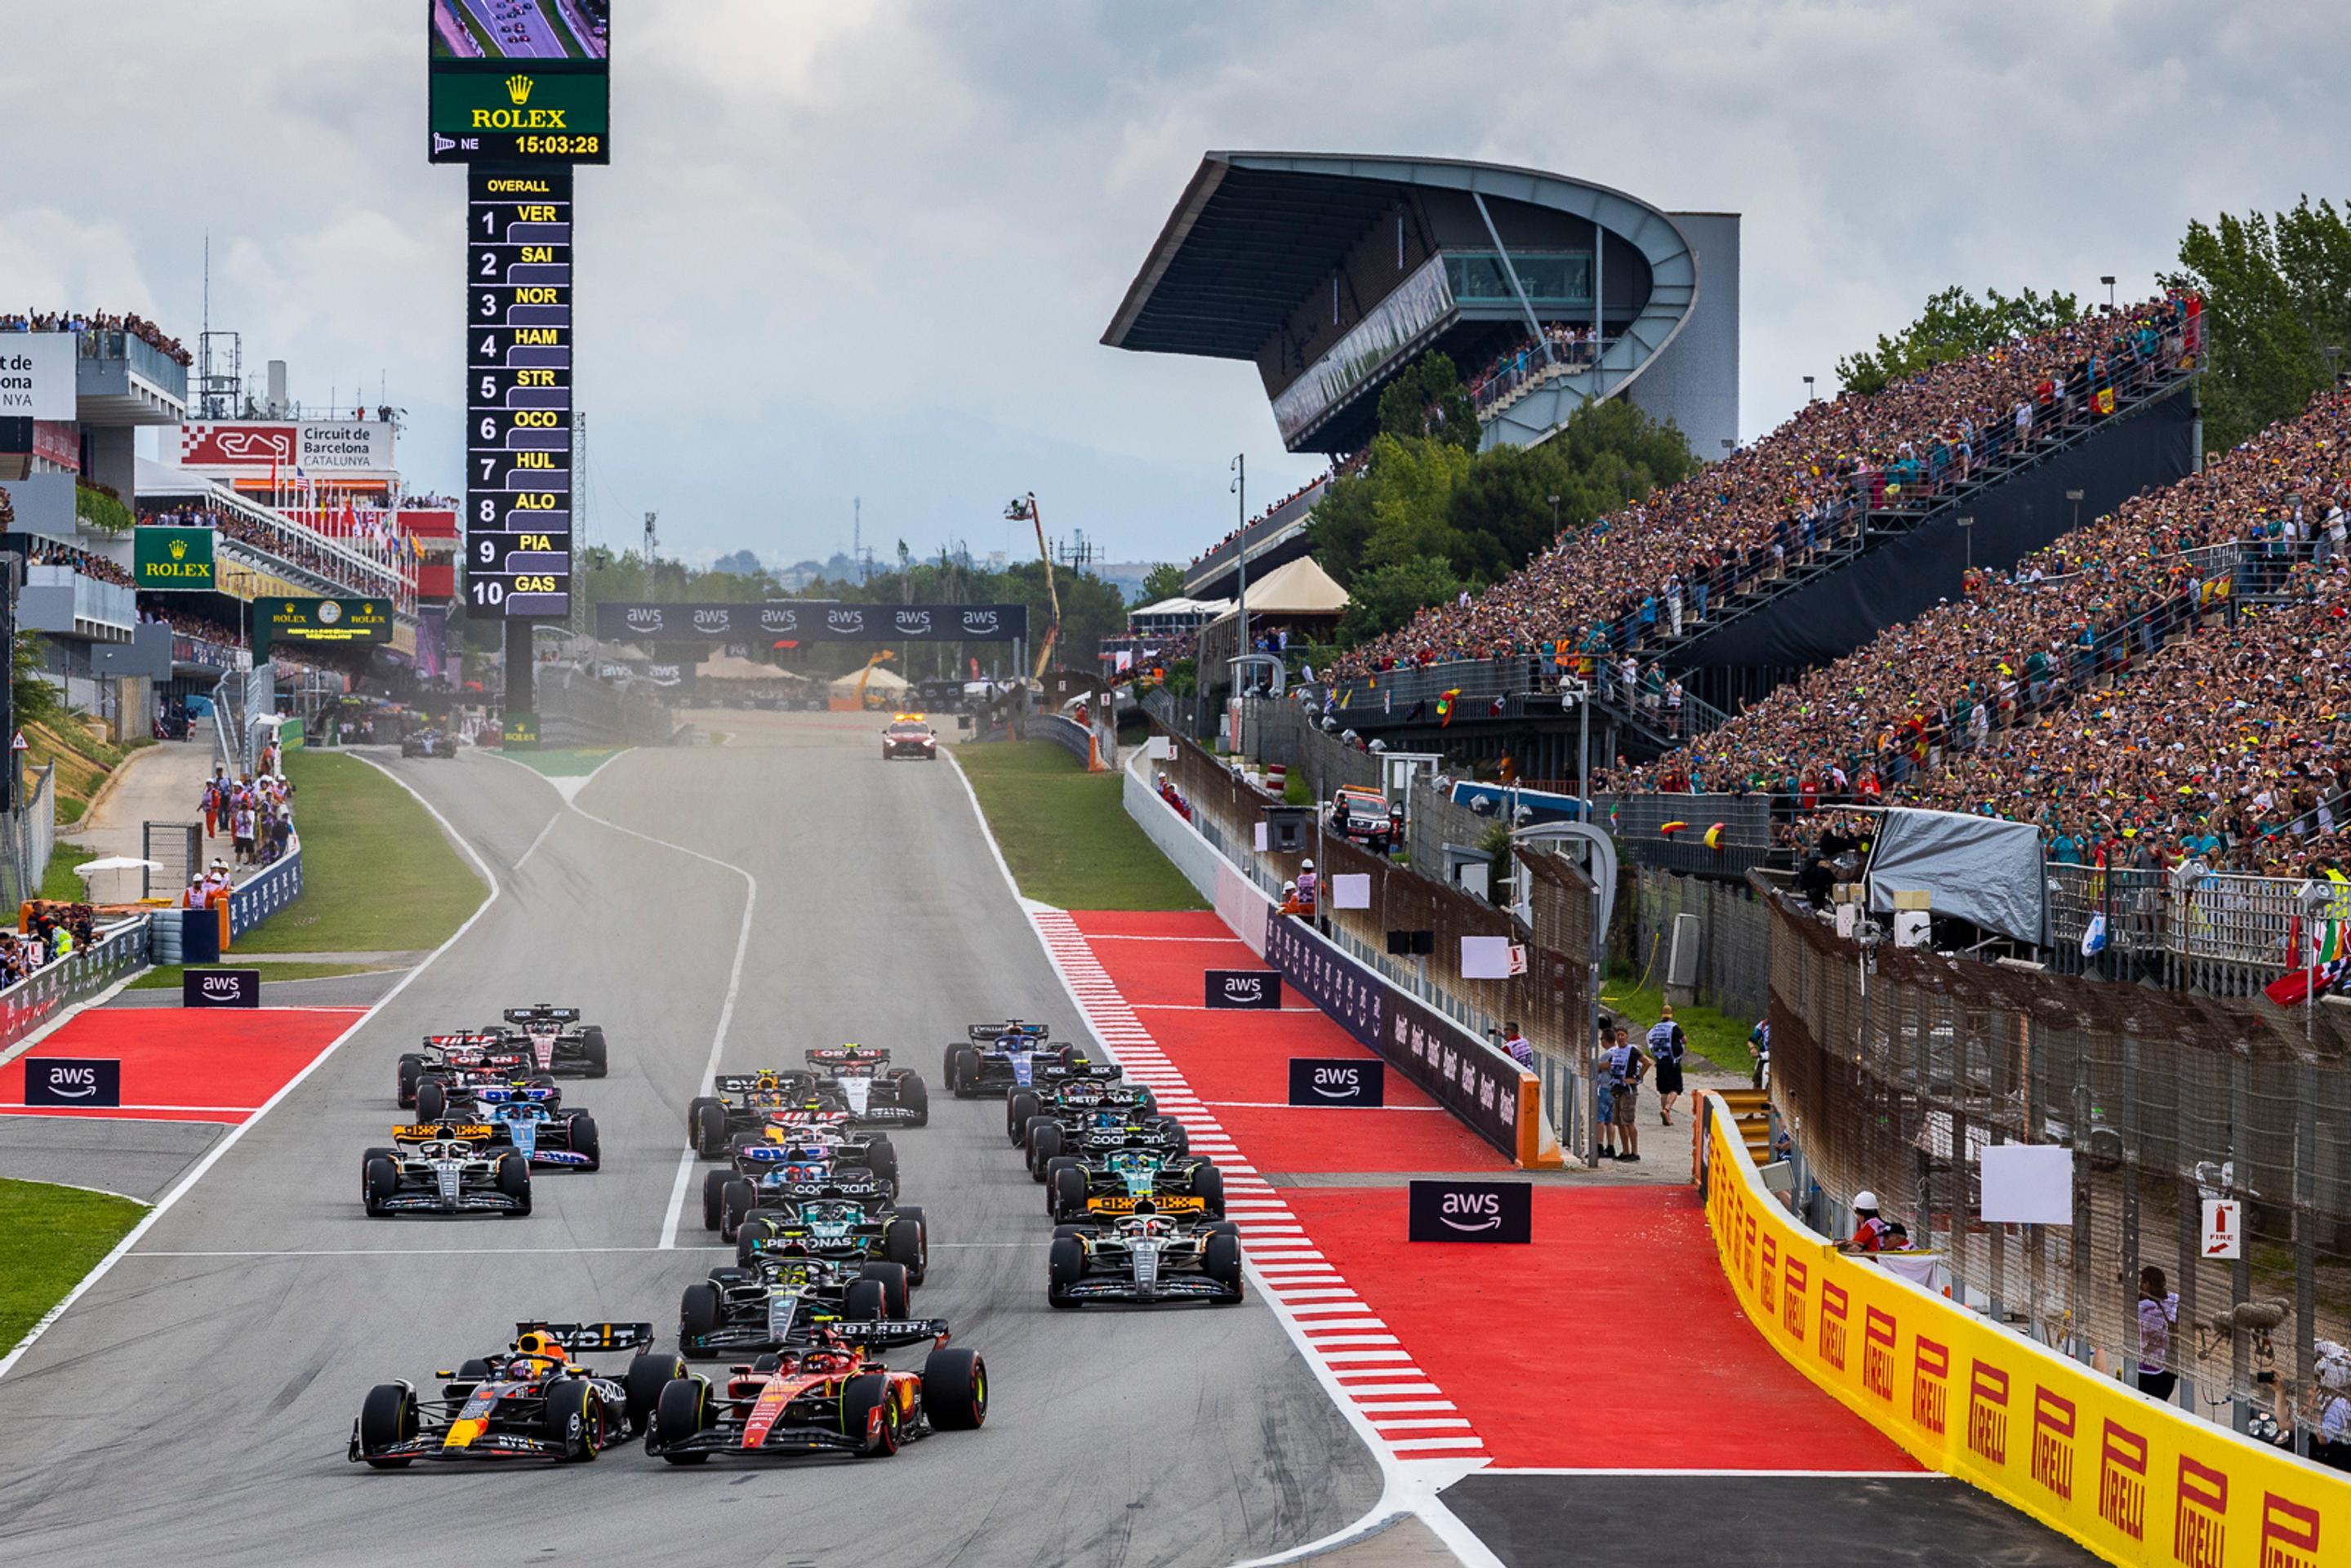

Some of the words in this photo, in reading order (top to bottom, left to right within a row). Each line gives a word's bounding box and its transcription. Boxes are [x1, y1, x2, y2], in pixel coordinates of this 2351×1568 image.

[472, 109, 566, 127] ROLEX
[461, 138, 479, 149] NE
[516, 136, 599, 154] 15:03:28
[488, 180, 550, 192] OVERALL
[482, 212, 493, 234] 1
[518, 206, 556, 221] VER
[481, 253, 496, 275] 2
[521, 247, 552, 262] SAI
[481, 294, 496, 316] 3
[515, 288, 557, 303] NOR
[480, 335, 496, 357] 4
[515, 330, 557, 345] HAM
[11, 354, 32, 370] de
[481, 376, 496, 399] 5
[517, 371, 555, 385] STR
[3, 394, 32, 406] NYA
[304, 428, 351, 439] Circuit
[354, 428, 370, 440] de
[480, 417, 496, 439] 6
[514, 412, 557, 426] OCO
[304, 443, 369, 453] Barcelona
[304, 456, 370, 466] CATALUNYA
[480, 459, 496, 480] 7
[517, 453, 554, 468] HUL
[480, 500, 496, 522] 8
[515, 494, 555, 509] ALO
[480, 541, 495, 563] 9
[520, 536, 551, 550] PIA
[146, 564, 210, 577] ROLEX
[473, 581, 503, 605] 10
[514, 577, 555, 591] GAS
[627, 608, 661, 622] aws
[693, 610, 728, 624] aws
[761, 610, 796, 623] aws
[827, 610, 862, 624] aws
[896, 611, 930, 625] aws
[963, 611, 997, 625] aws
[203, 977, 239, 991] aws
[1225, 978, 1261, 992] aws
[50, 1067, 95, 1084] aws
[1315, 1068, 1358, 1085] aws
[1442, 1193, 1499, 1214] aws
[1819, 1278, 1848, 1372] PIRELLI
[1863, 1303, 1896, 1401] PIRELLI
[1912, 1334, 1949, 1436] PIRELLI
[1967, 1358, 2009, 1465] PIRELLI
[2031, 1383, 2076, 1501] PIRELLI
[2099, 1417, 2148, 1542] PIRELLI
[2174, 1454, 2228, 1568] PIRELLI
